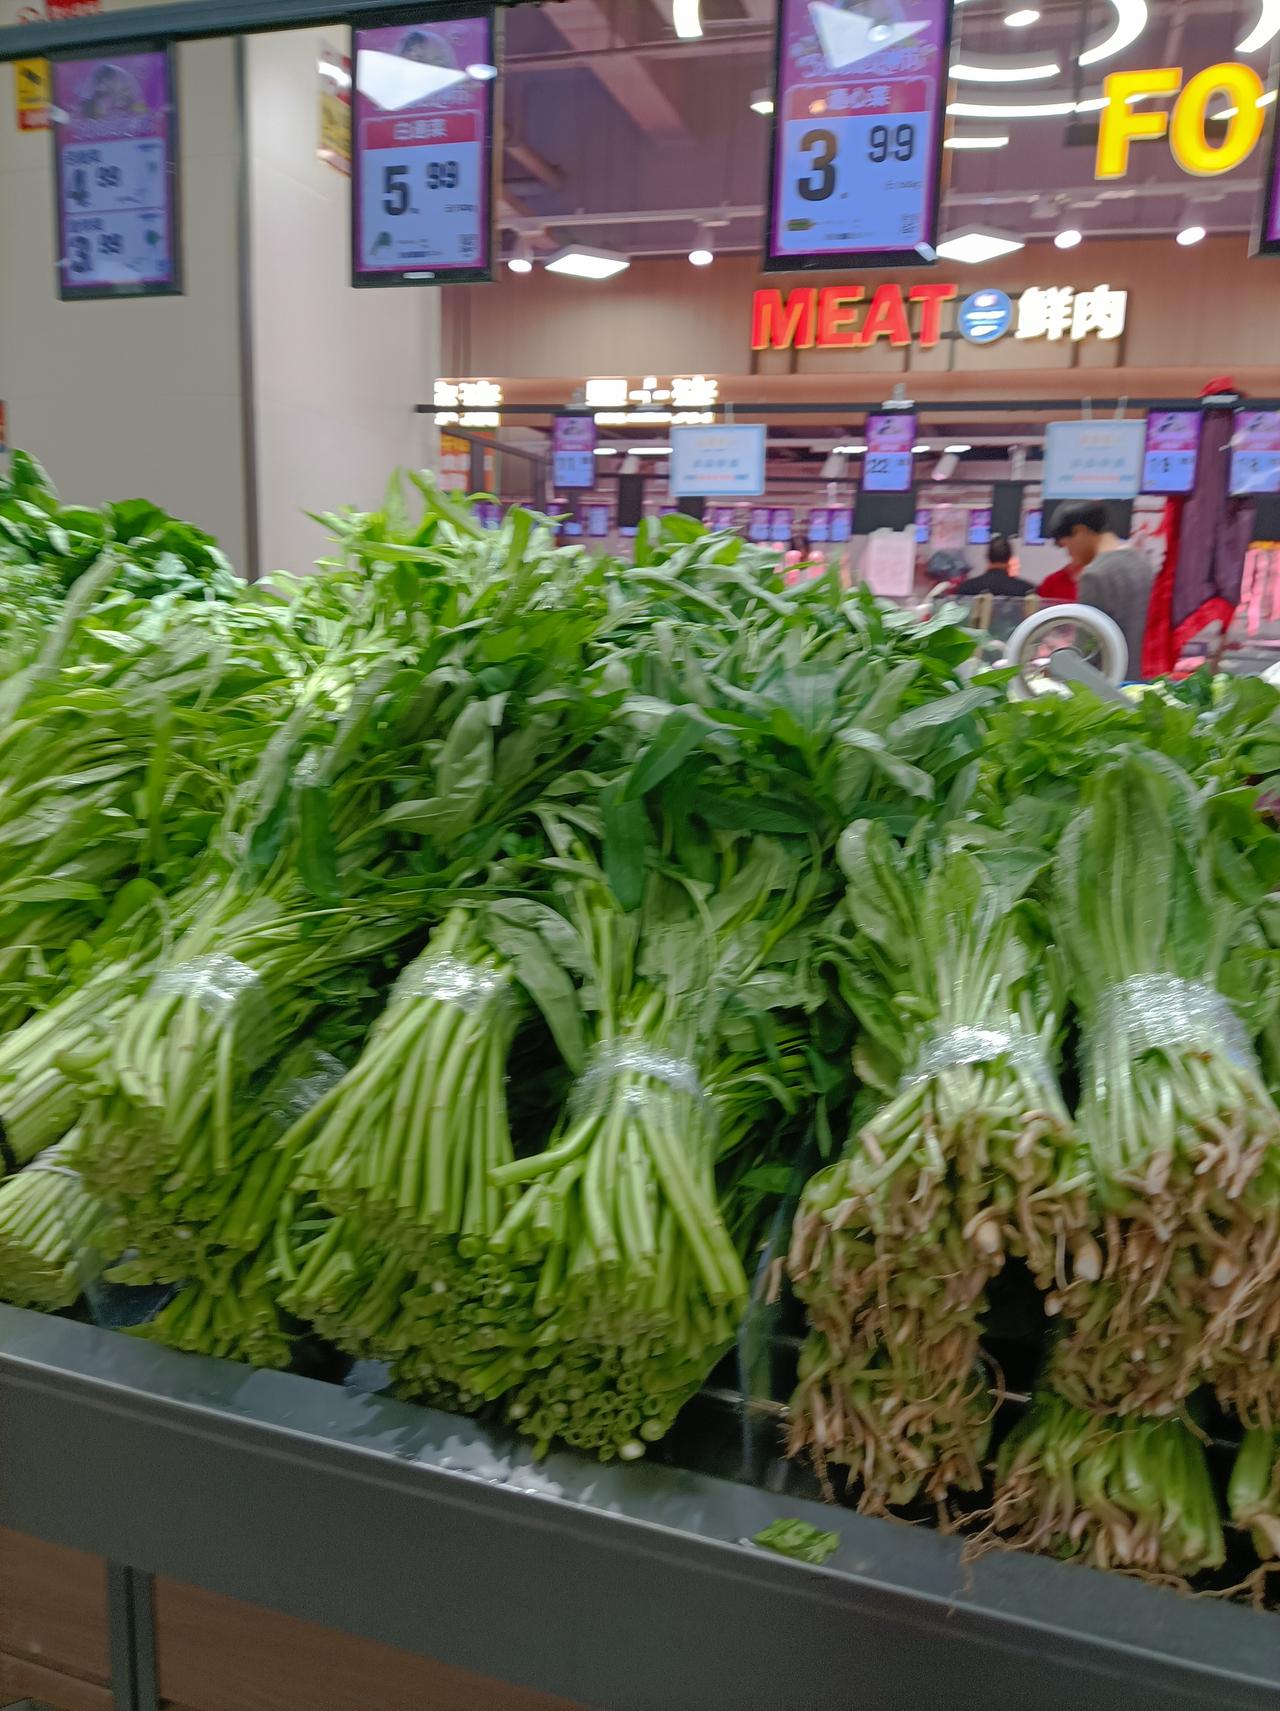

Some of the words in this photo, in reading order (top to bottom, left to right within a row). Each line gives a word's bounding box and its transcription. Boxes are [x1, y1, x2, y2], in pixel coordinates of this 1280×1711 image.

[1095, 62, 1265, 180] FO
[383, 165, 409, 216] 5
[427, 161, 459, 189] 99
[797, 129, 838, 201] 3
[869, 124, 914, 163] 99
[752, 283, 957, 350] MEAT
